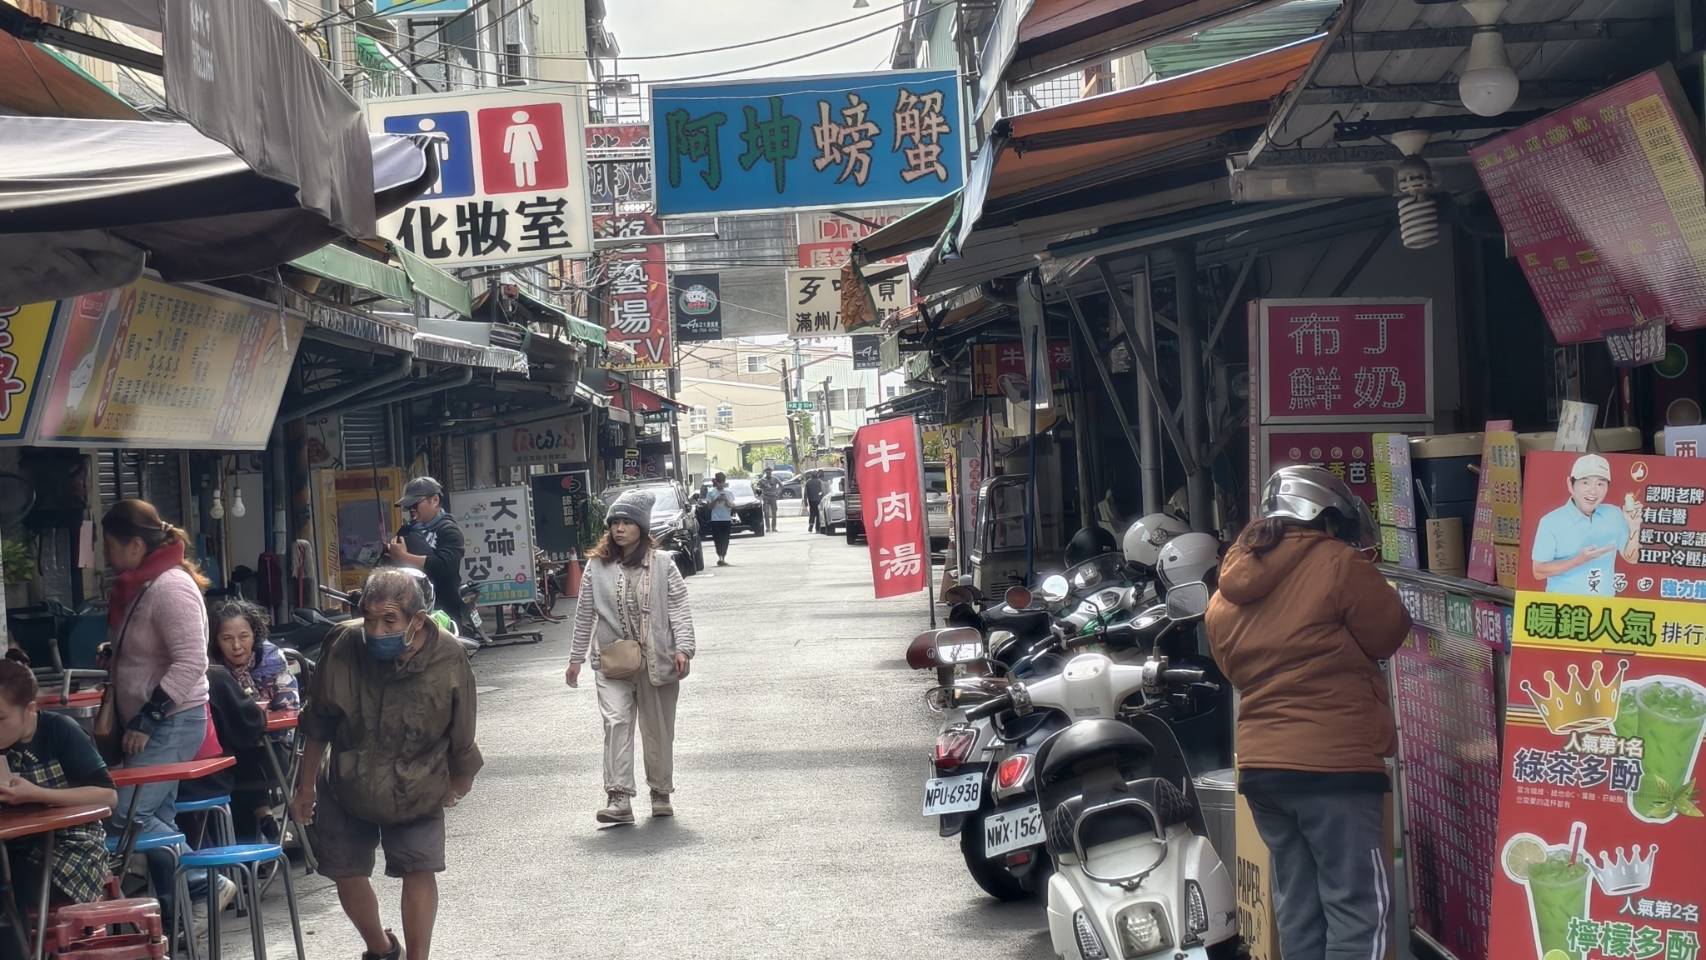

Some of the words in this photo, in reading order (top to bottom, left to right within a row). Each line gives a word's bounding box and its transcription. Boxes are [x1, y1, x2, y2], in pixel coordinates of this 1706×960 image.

[666, 87, 951, 194] 阿坤螃蟹
[396, 196, 573, 259] 化妝室
[1288, 313, 1406, 356] 布丁
[1288, 366, 1407, 410] 鮮奶
[865, 439, 921, 580] 牛肉湯
[1642, 507, 1688, 525] 有信譽
[1646, 486, 1705, 505] 認明老牌
[1525, 603, 1656, 646] 暢銷人氣
[1661, 621, 1706, 645] 排行
[1564, 732, 1644, 759] 人氣第1名
[1514, 748, 1643, 792] 綠茶多酚
[1237, 856, 1260, 908] PAPER
[1619, 896, 1699, 923] 人氣第2名
[1567, 917, 1701, 960] 檸檬多酚
